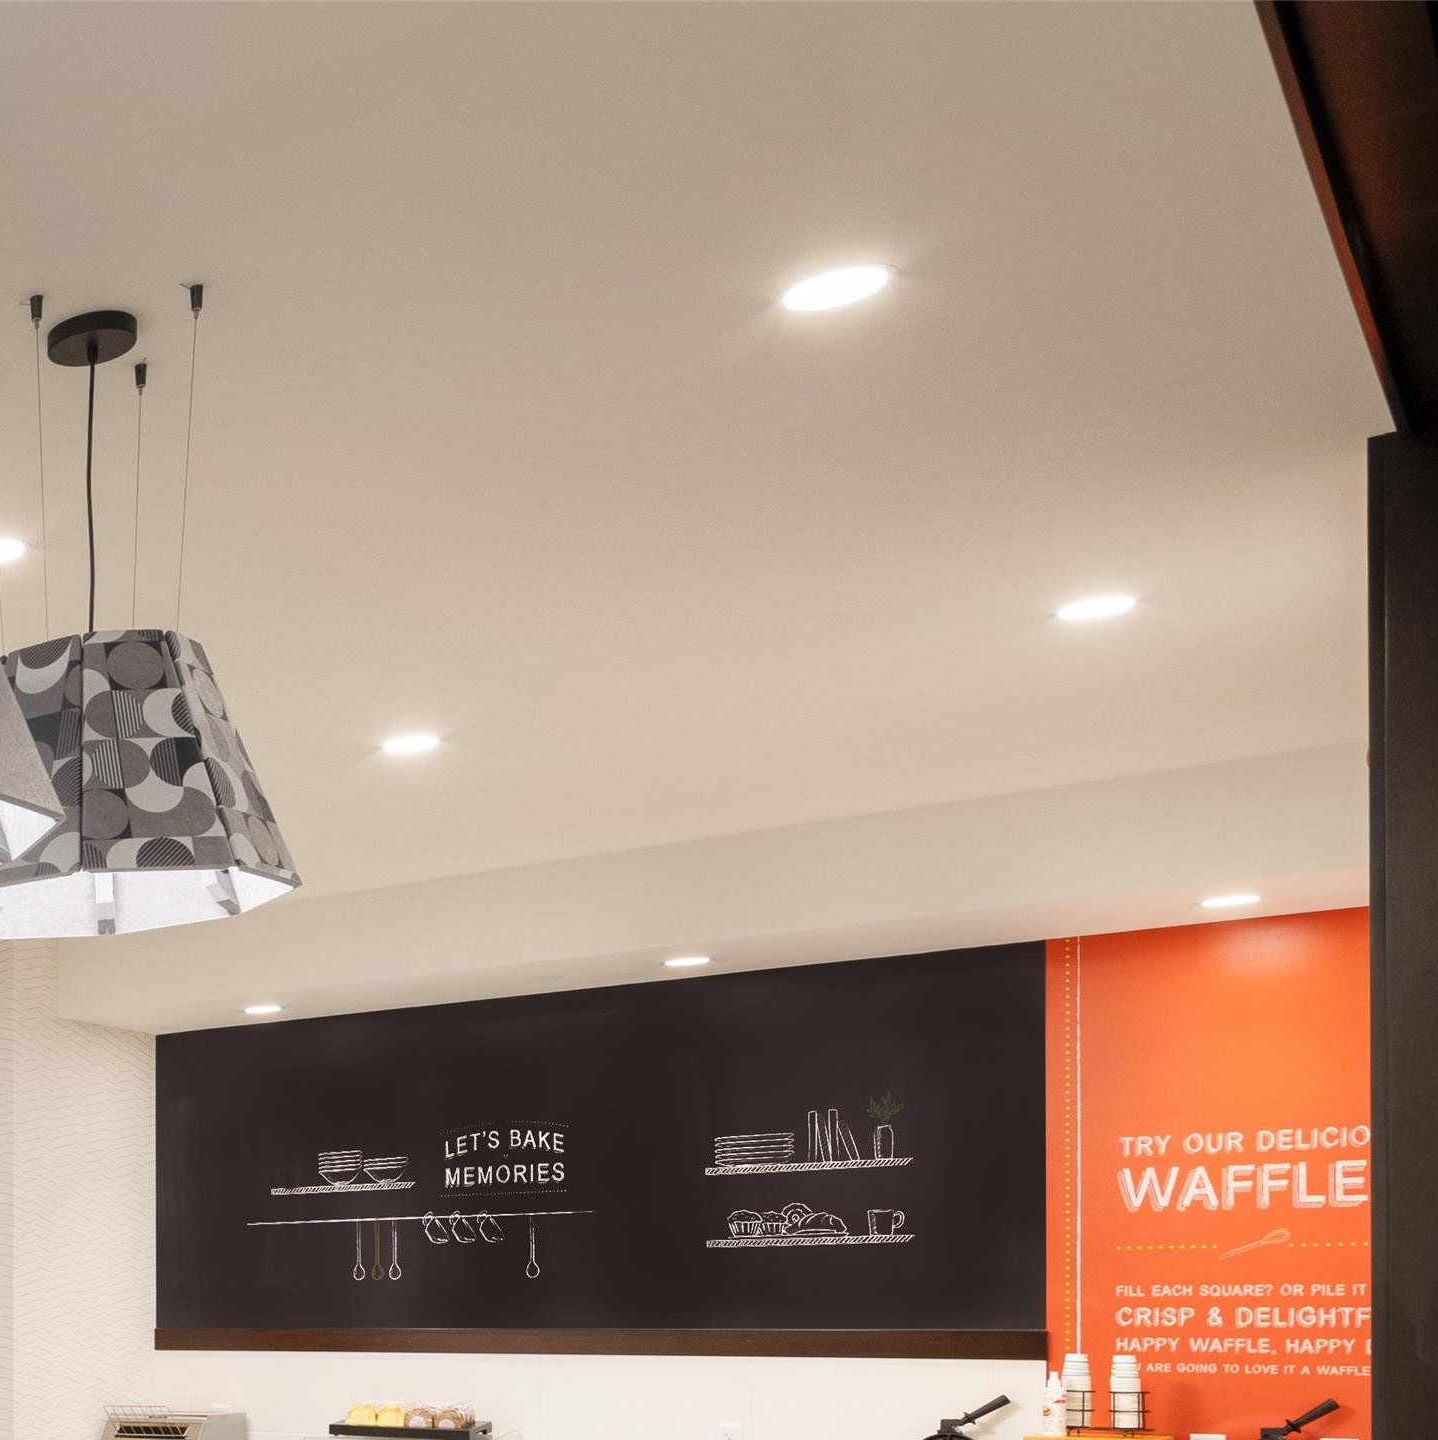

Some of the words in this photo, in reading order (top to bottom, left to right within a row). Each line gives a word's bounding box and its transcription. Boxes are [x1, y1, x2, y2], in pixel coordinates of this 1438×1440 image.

[445, 1130, 500, 1159] LET'S
[509, 1129, 565, 1153] BAKE
[1119, 1134, 1172, 1157] TRY
[1184, 1131, 1244, 1155] OUR
[445, 1162, 565, 1188] MEMORIES
[1117, 1159, 1369, 1213] WAFFLE
[1115, 1284, 1145, 1297] FILL
[1151, 1284, 1193, 1297] EACH
[1199, 1283, 1273, 1297] SQUARE?
[1280, 1283, 1304, 1296] OR
[1310, 1283, 1346, 1296] PILE
[1352, 1283, 1367, 1296] IT
[1115, 1306, 1195, 1328] CRISP
[1206, 1306, 1224, 1328] &
[1115, 1337, 1180, 1352] HAPPY
[1188, 1338, 1277, 1355] WAFFLE,
[1285, 1338, 1356, 1355] HAPPY
[1146, 1363, 1172, 1373] ARE
[1176, 1363, 1218, 1374] GOING
[1223, 1363, 1240, 1374] TO
[1244, 1364, 1279, 1375] LOVE
[1283, 1364, 1296, 1375] IT
[1300, 1365, 1311, 1376] A
[1316, 1365, 1371, 1377] WAFFLE
